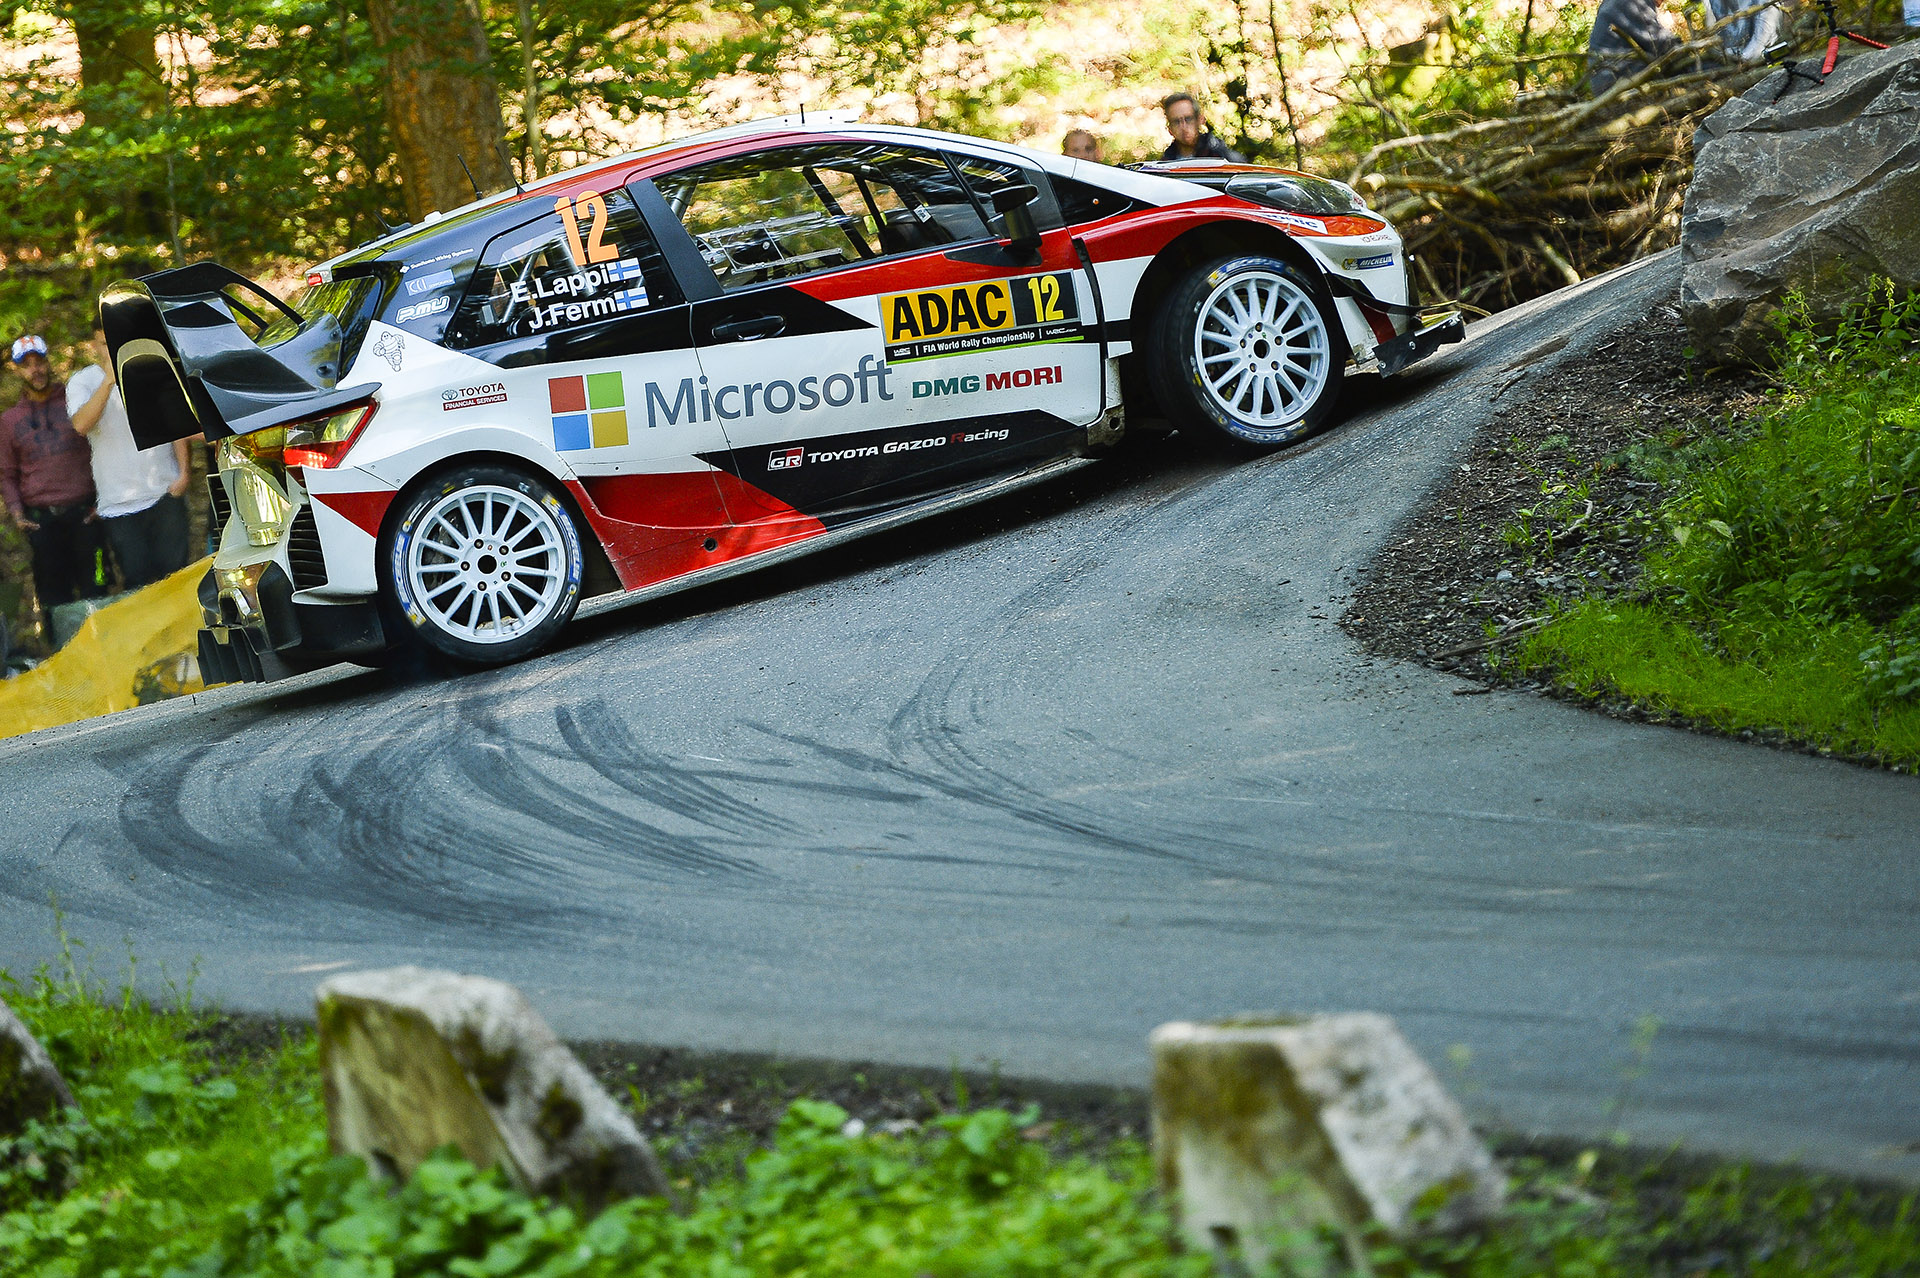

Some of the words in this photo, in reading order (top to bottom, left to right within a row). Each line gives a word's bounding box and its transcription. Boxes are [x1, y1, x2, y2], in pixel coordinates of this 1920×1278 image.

[554, 190, 620, 266] 12
[1359, 256, 1393, 266] MICHELIN
[509, 263, 610, 303] E.Lappi
[1028, 275, 1065, 323] 12
[528, 296, 617, 330] J.Ferm
[891, 283, 1007, 341] ADAC
[922, 344, 937, 354] FIA
[936, 341, 960, 352] World
[961, 338, 981, 348] Rally
[982, 331, 1036, 346] Championship
[458, 382, 506, 397] TOYOTA
[644, 354, 894, 428] Microsoft
[912, 375, 980, 399] DMG
[985, 365, 1063, 391] MORI
[444, 399, 476, 410] FINANCIAL
[476, 394, 506, 405] SERVICES
[769, 454, 802, 469] GR
[807, 446, 879, 464] TOYOTA
[882, 436, 947, 454] GAZOO
[950, 428, 1010, 445] Racing
